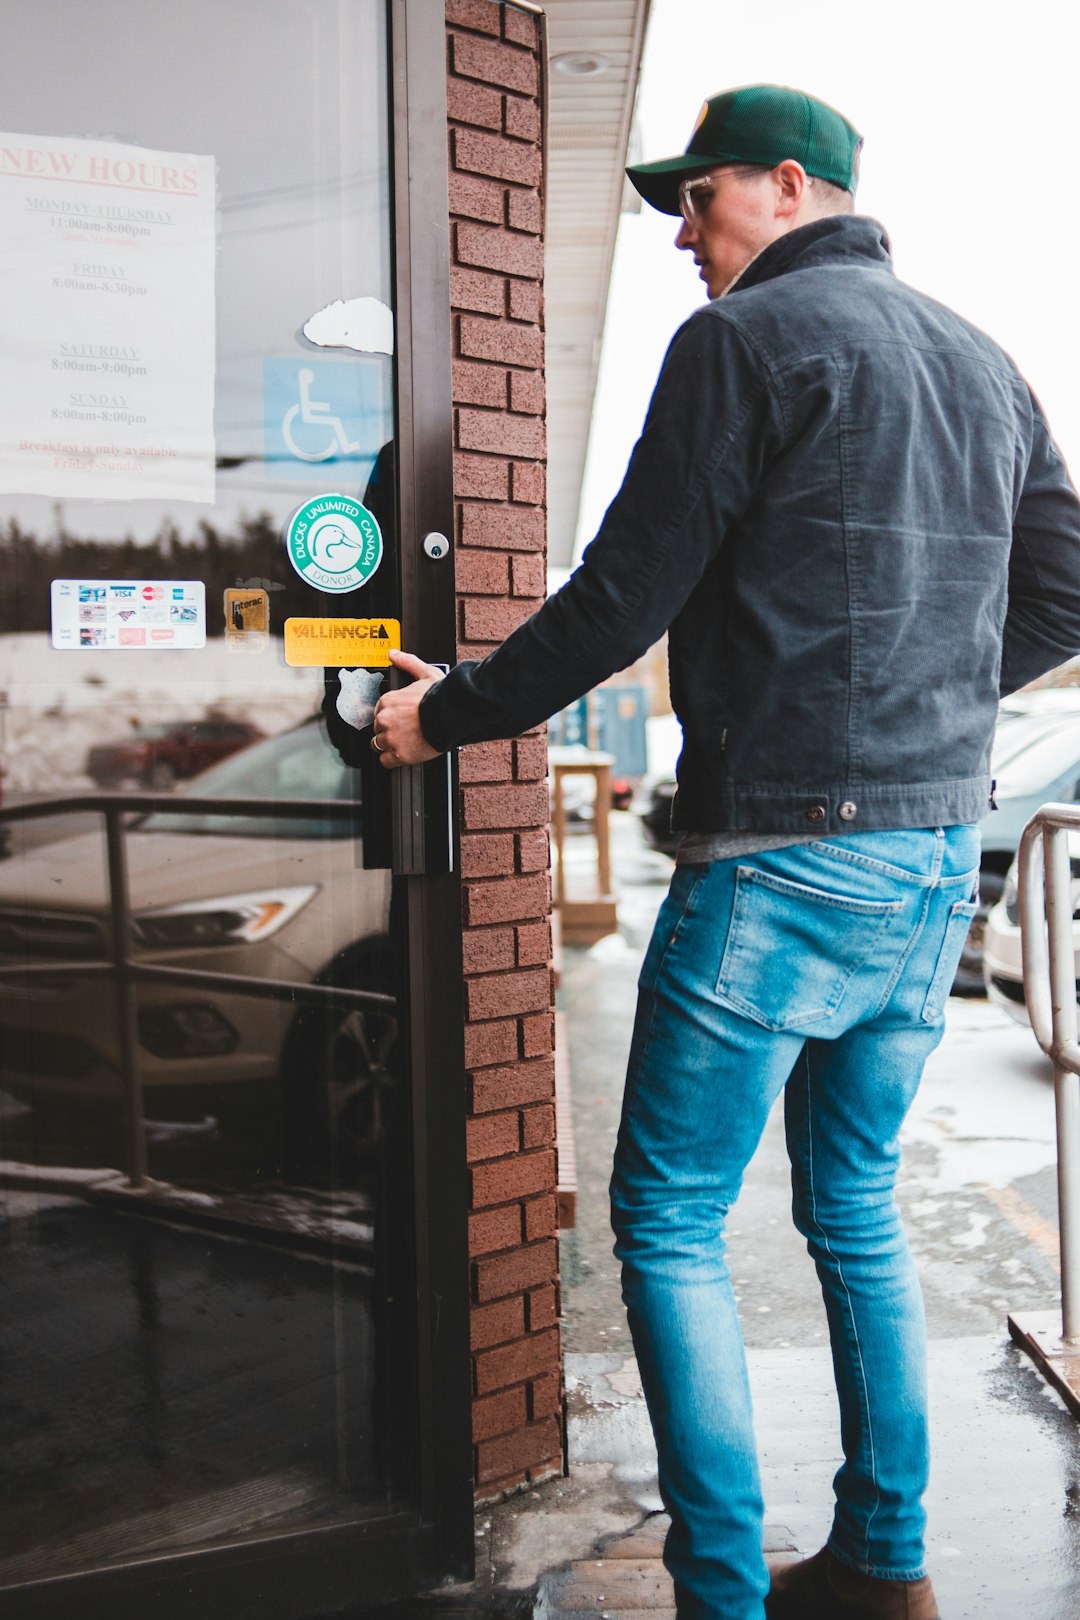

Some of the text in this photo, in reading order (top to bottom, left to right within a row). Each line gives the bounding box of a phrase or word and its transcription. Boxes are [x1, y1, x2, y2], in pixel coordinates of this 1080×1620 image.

[0, 148, 199, 192] NEW HOURS
[26, 197, 174, 224] MONDAY-THURSDAY
[50, 216, 151, 237] 11:00am-8:00pm
[73, 262, 128, 278] FRIDAY
[52, 277, 148, 297] 8:00am-8:30pm
[60, 342, 139, 358] SATURDAY
[51, 358, 147, 376] 8:00am-9:00pm
[69, 392, 129, 407] SUNDAY
[51, 408, 147, 425] 8:00am-8:00pm
[19, 440, 178, 457] Breakfast is only available
[53, 458, 145, 473] Friday-Sunday
[294, 501, 375, 566] DUCKS UNLIMITED CANADA
[312, 570, 354, 586] DONOR
[231, 596, 263, 614] Interac
[295, 624, 378, 639] ALLIANCE
